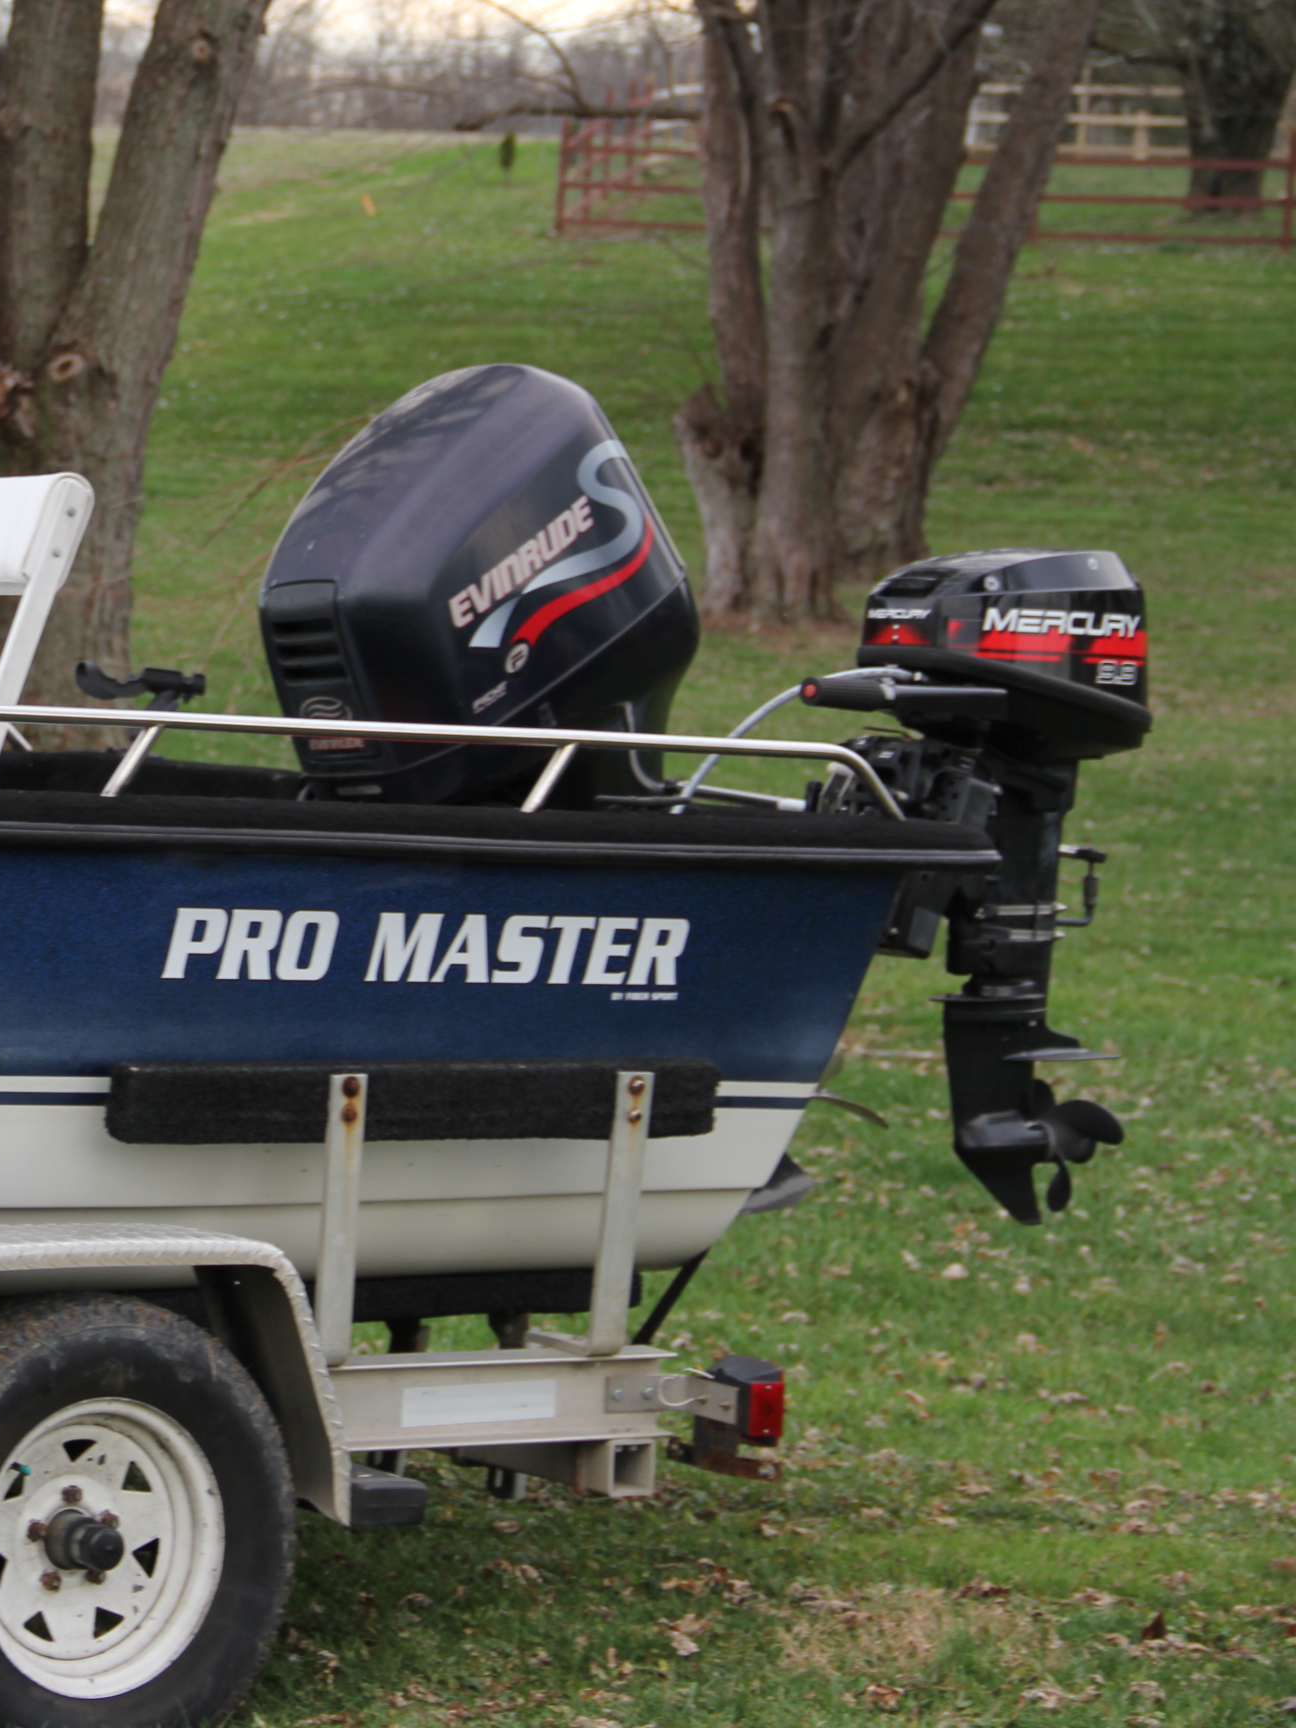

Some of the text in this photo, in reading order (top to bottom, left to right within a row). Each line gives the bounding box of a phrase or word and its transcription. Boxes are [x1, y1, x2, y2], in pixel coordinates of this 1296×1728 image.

[448, 495, 594, 628] EVINRUDE
[867, 608, 932, 619] MERCURY
[982, 607, 1141, 638] MERCURY
[160, 907, 691, 985] PRO MASTER
